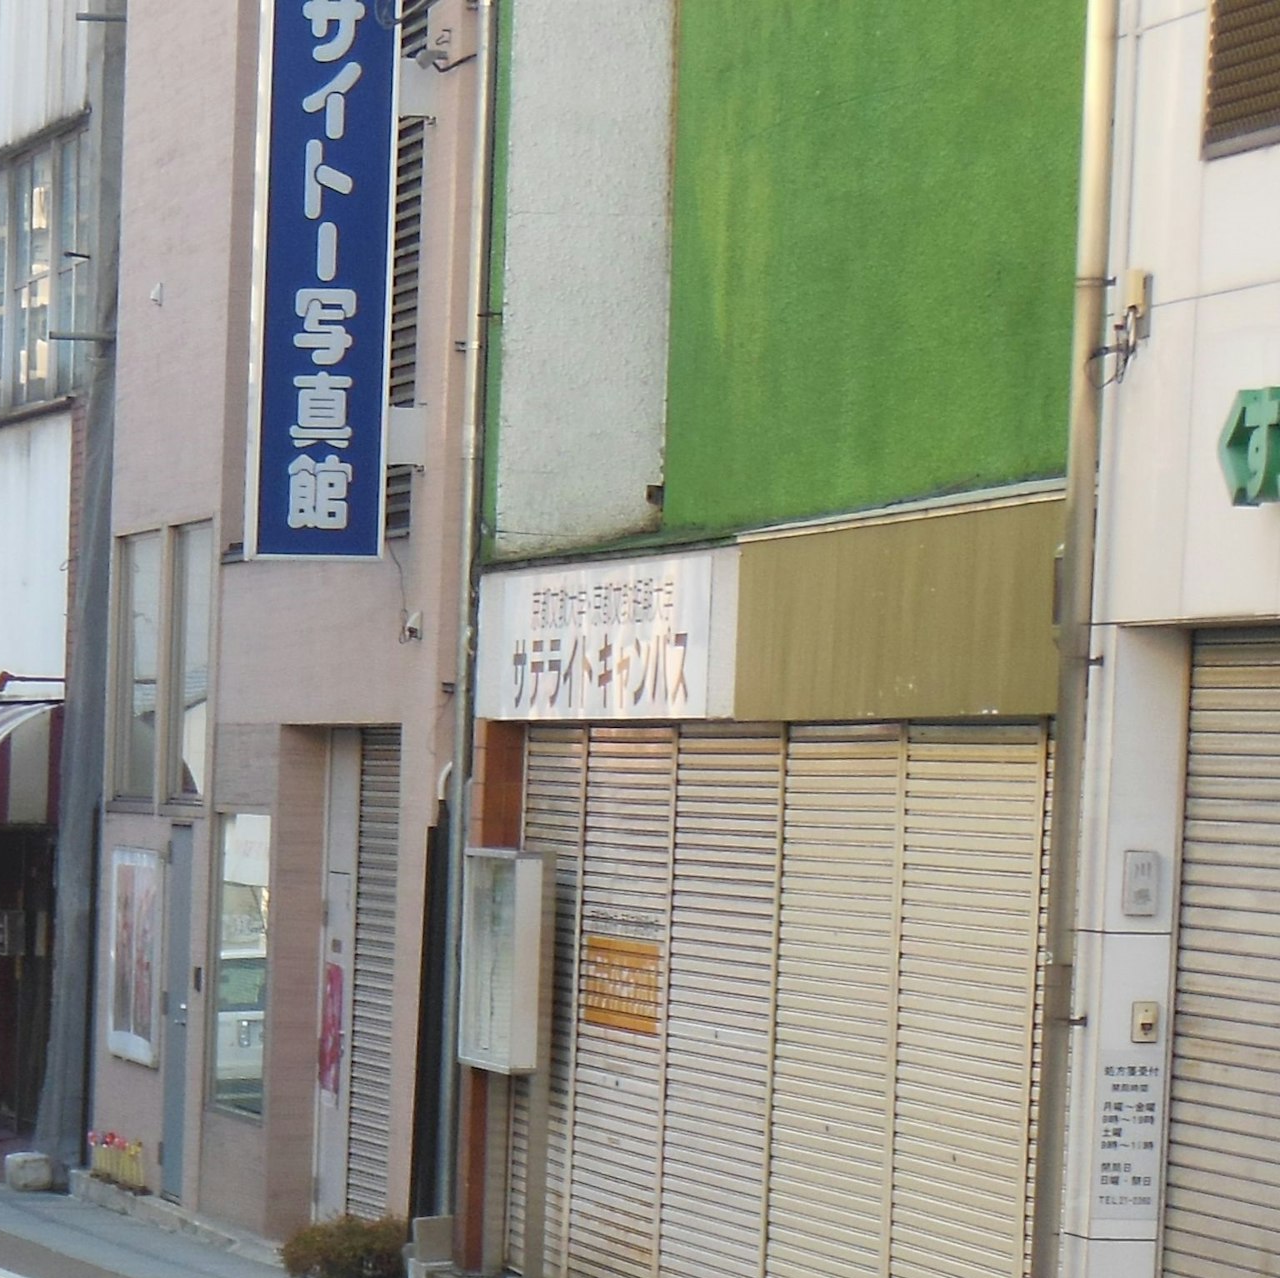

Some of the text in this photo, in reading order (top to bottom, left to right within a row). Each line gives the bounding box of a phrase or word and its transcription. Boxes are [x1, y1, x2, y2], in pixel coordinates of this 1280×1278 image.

[288, 0, 366, 530] サイトー写真館
[513, 630, 690, 710] サテライトキャンパス
